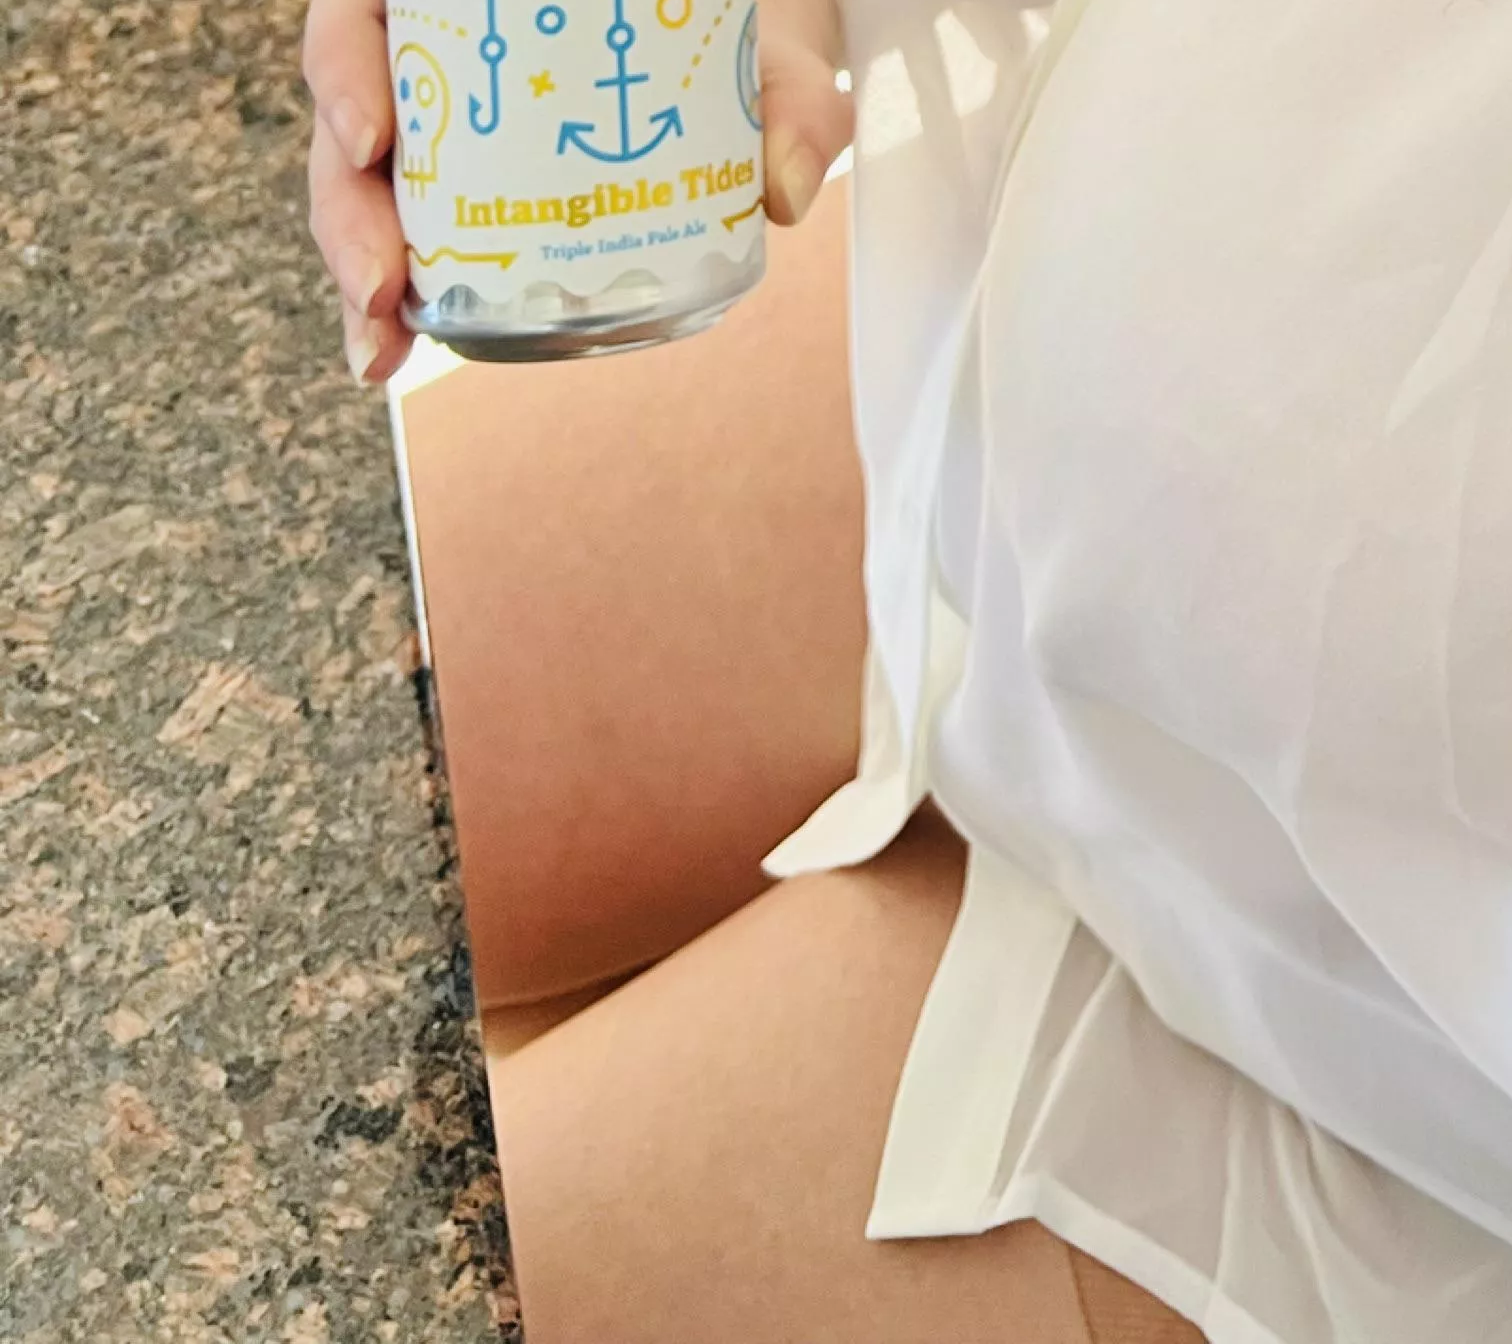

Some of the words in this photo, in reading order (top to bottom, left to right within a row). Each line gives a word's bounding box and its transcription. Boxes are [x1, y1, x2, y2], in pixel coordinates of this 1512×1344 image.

[455, 178, 673, 228] Intangible
[680, 158, 754, 201] Tides
[540, 241, 593, 261] Triple
[598, 233, 643, 254] India
[647, 225, 680, 246] Pale
[682, 217, 707, 238] Ale
